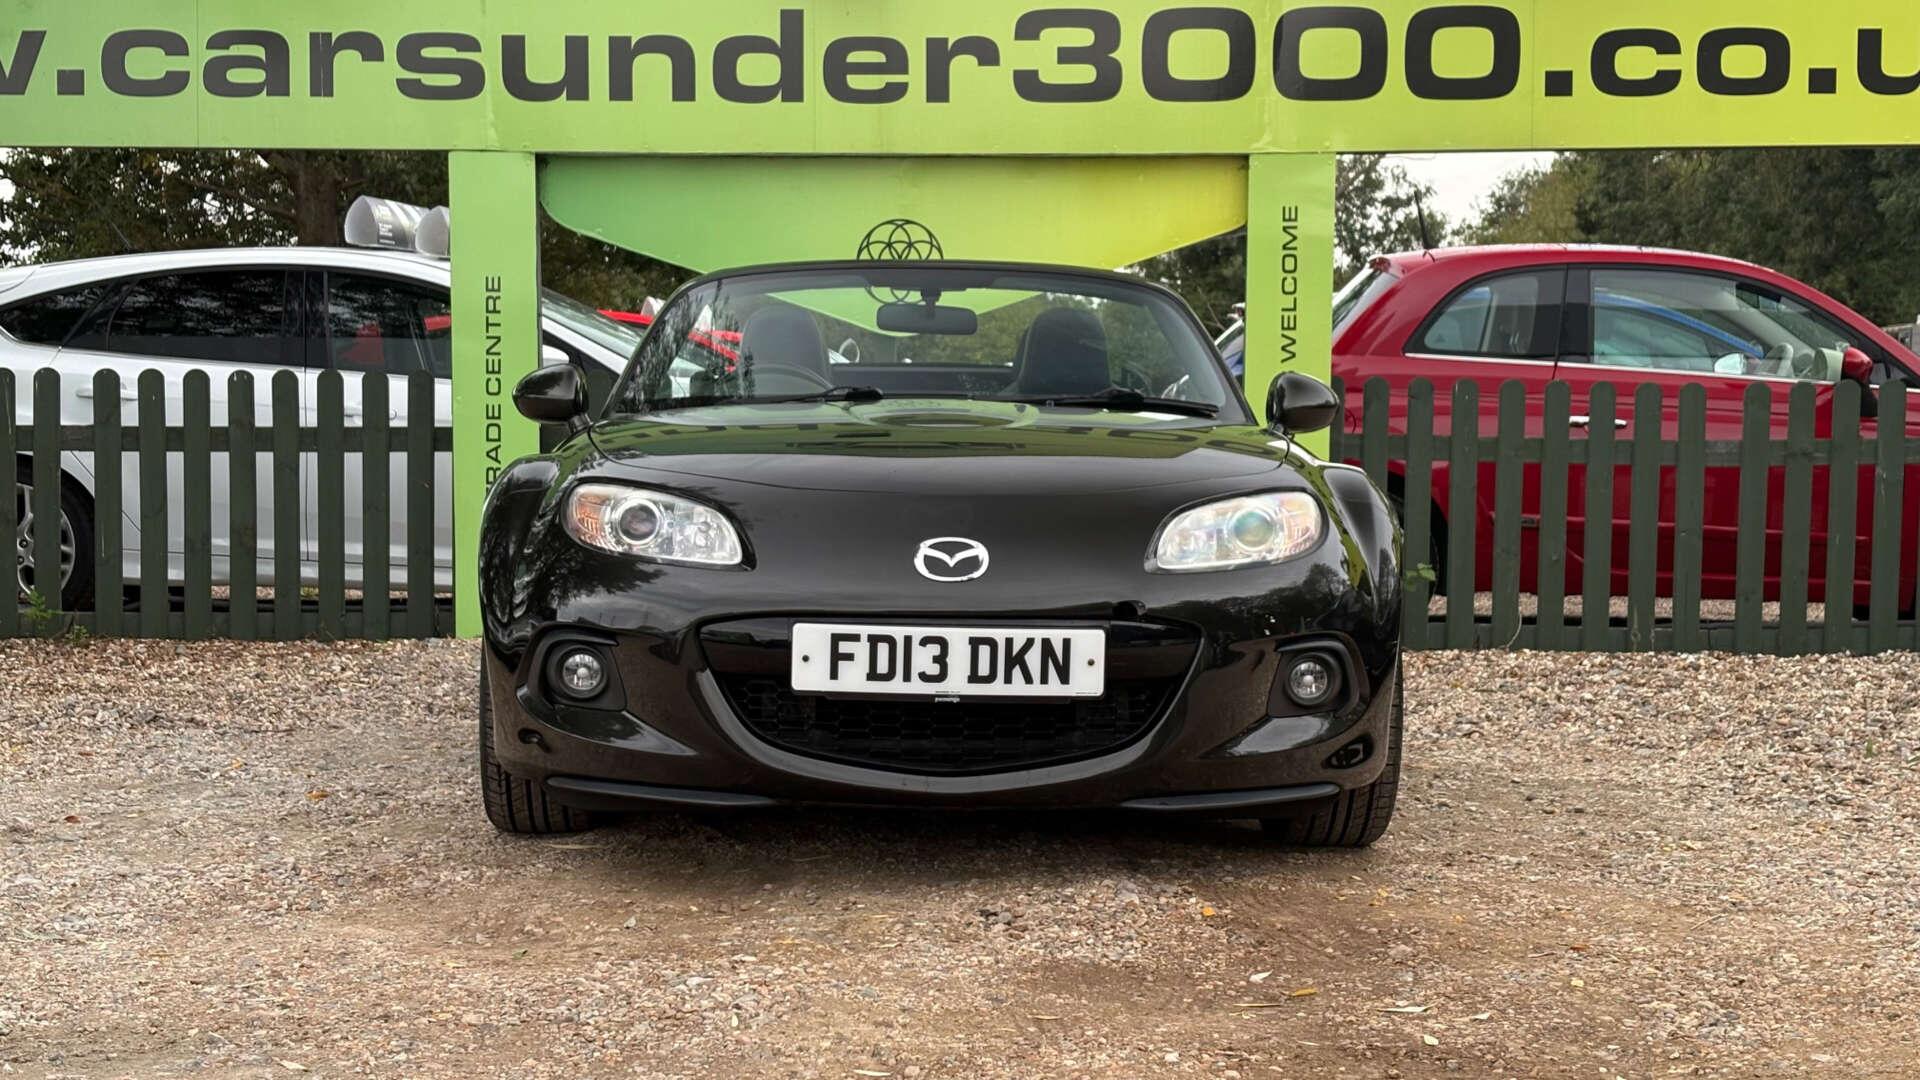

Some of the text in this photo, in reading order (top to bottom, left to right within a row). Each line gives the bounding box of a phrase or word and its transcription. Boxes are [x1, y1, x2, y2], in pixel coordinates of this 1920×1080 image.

[1281, 205, 1298, 363] WELCOME
[485, 275, 501, 497] RADE CENTRE
[829, 632, 1072, 685] FD13 DKN
